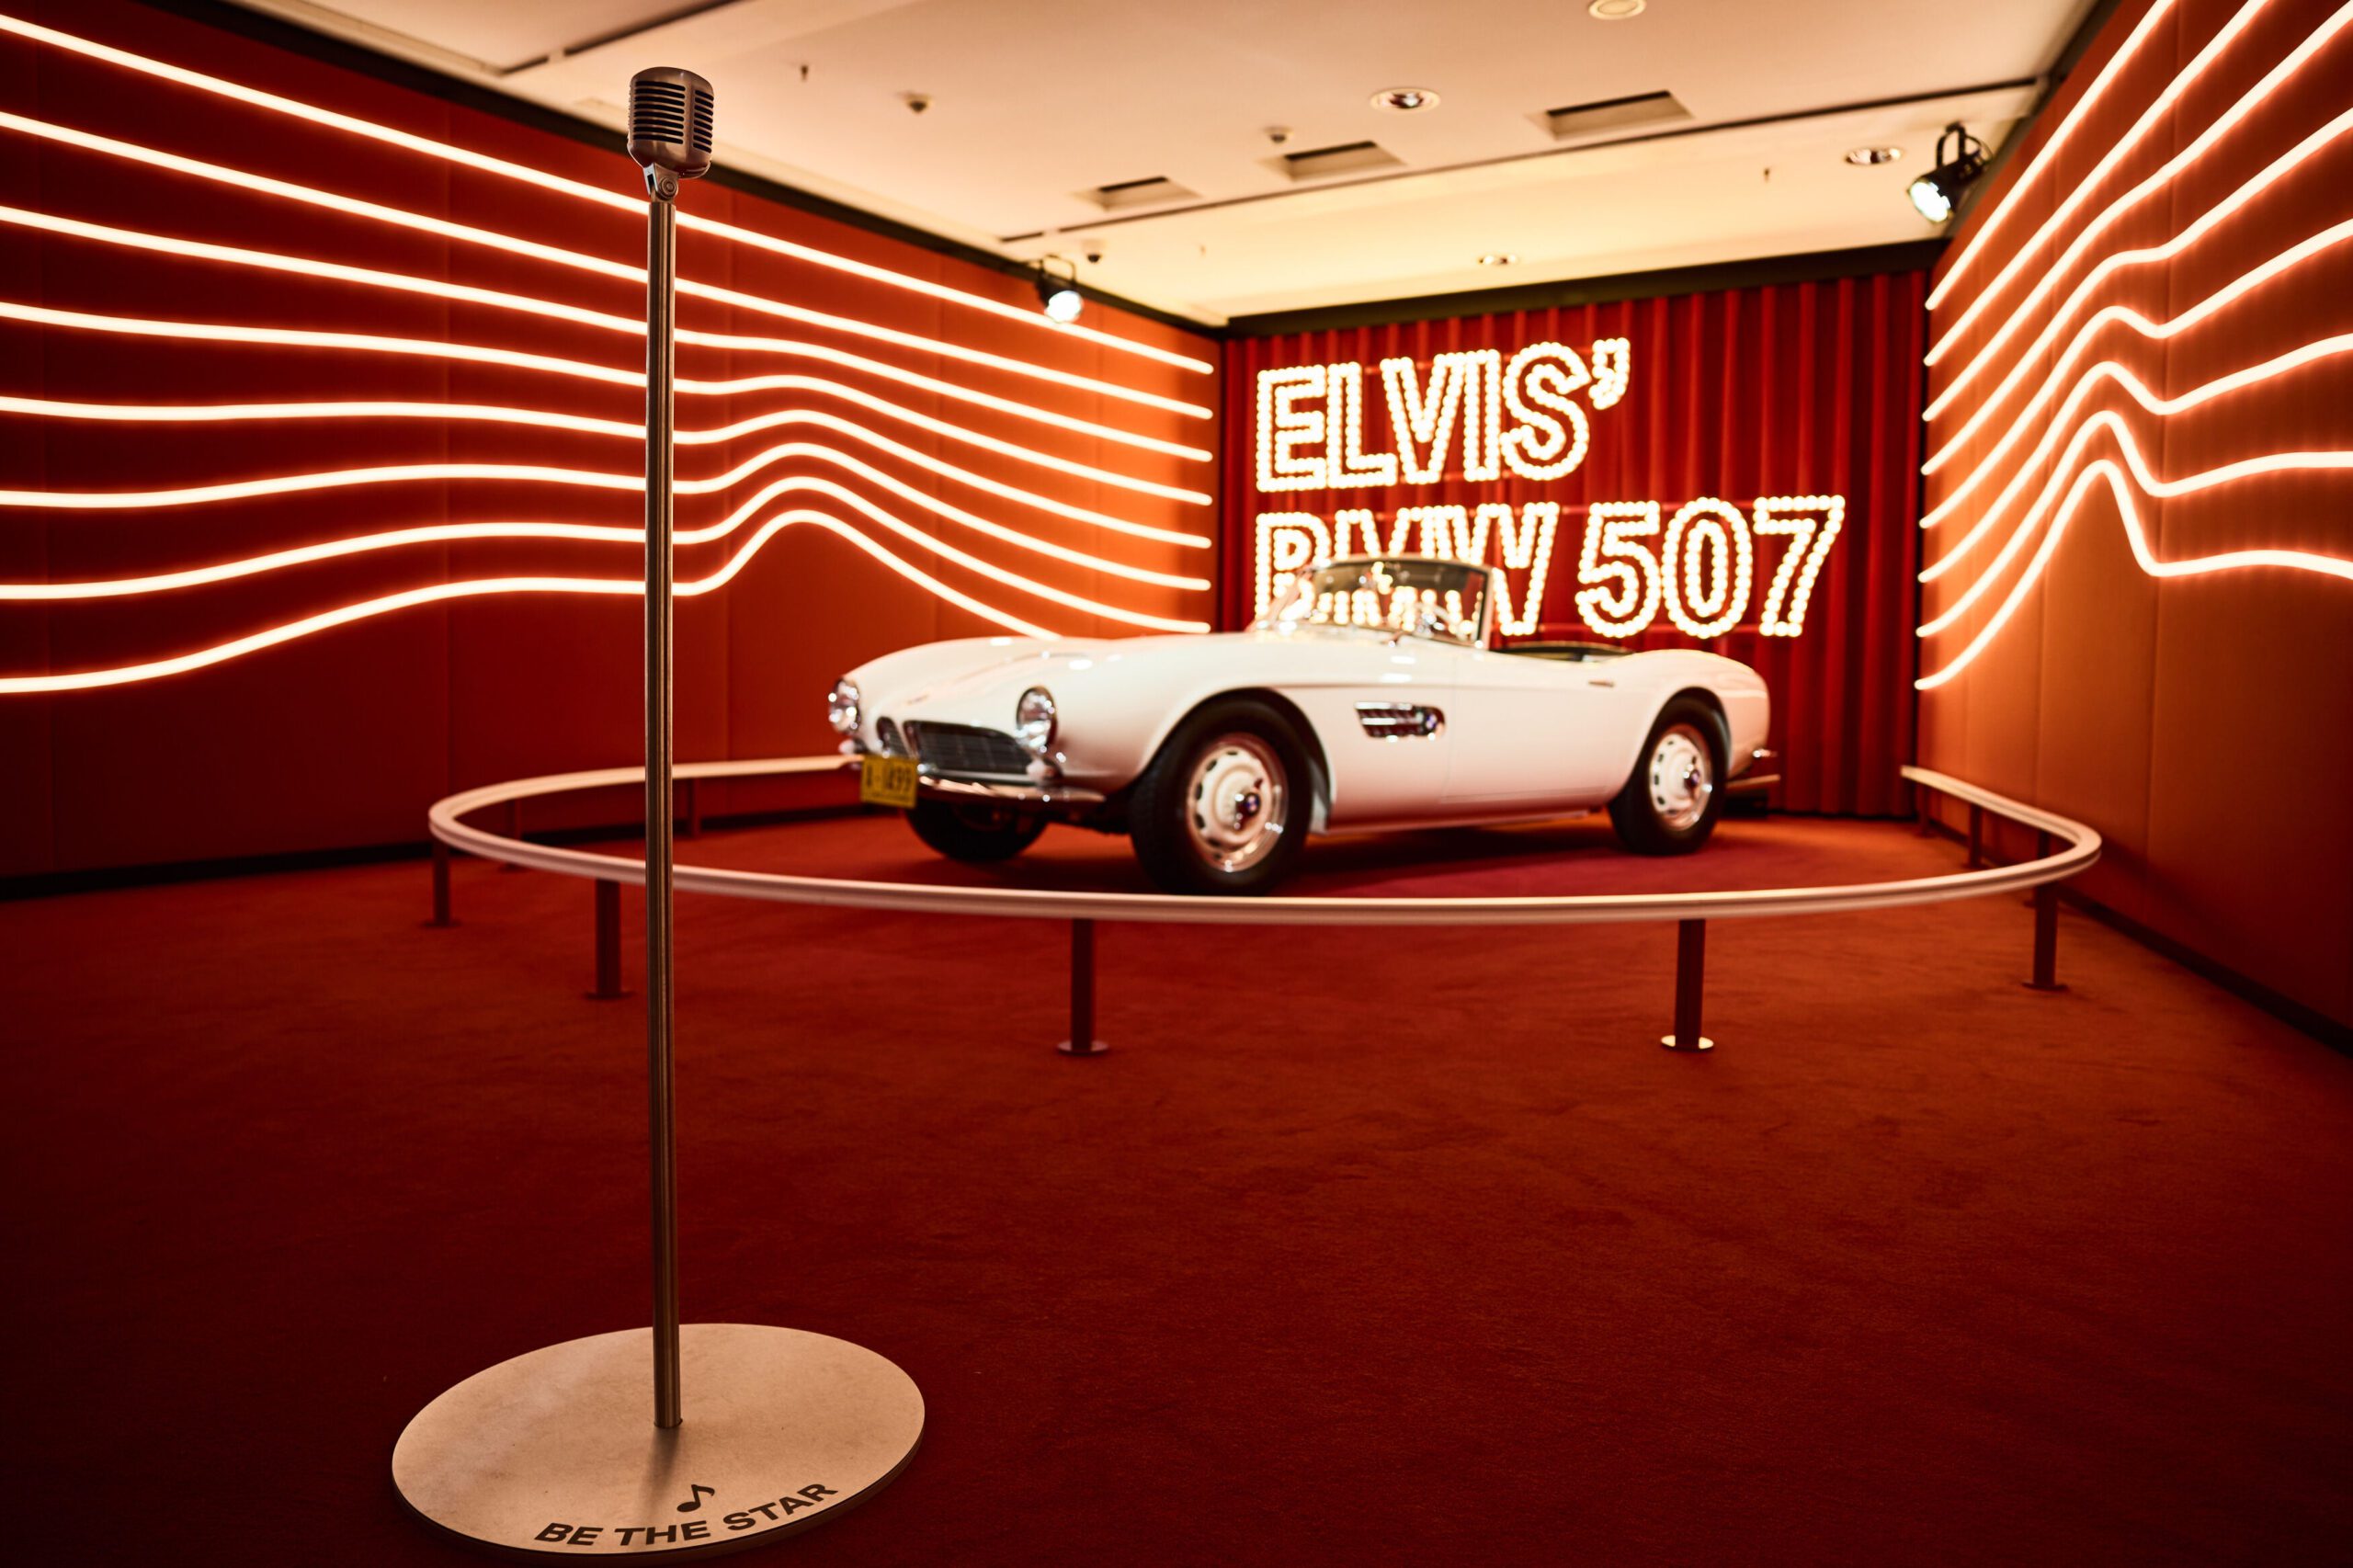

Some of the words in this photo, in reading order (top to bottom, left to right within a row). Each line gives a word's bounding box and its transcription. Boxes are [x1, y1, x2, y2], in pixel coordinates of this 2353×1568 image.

[1575, 494, 1845, 639] 507
[534, 1522, 604, 1546] BE
[614, 1520, 711, 1546] THE
[722, 1483, 838, 1531] STAR
